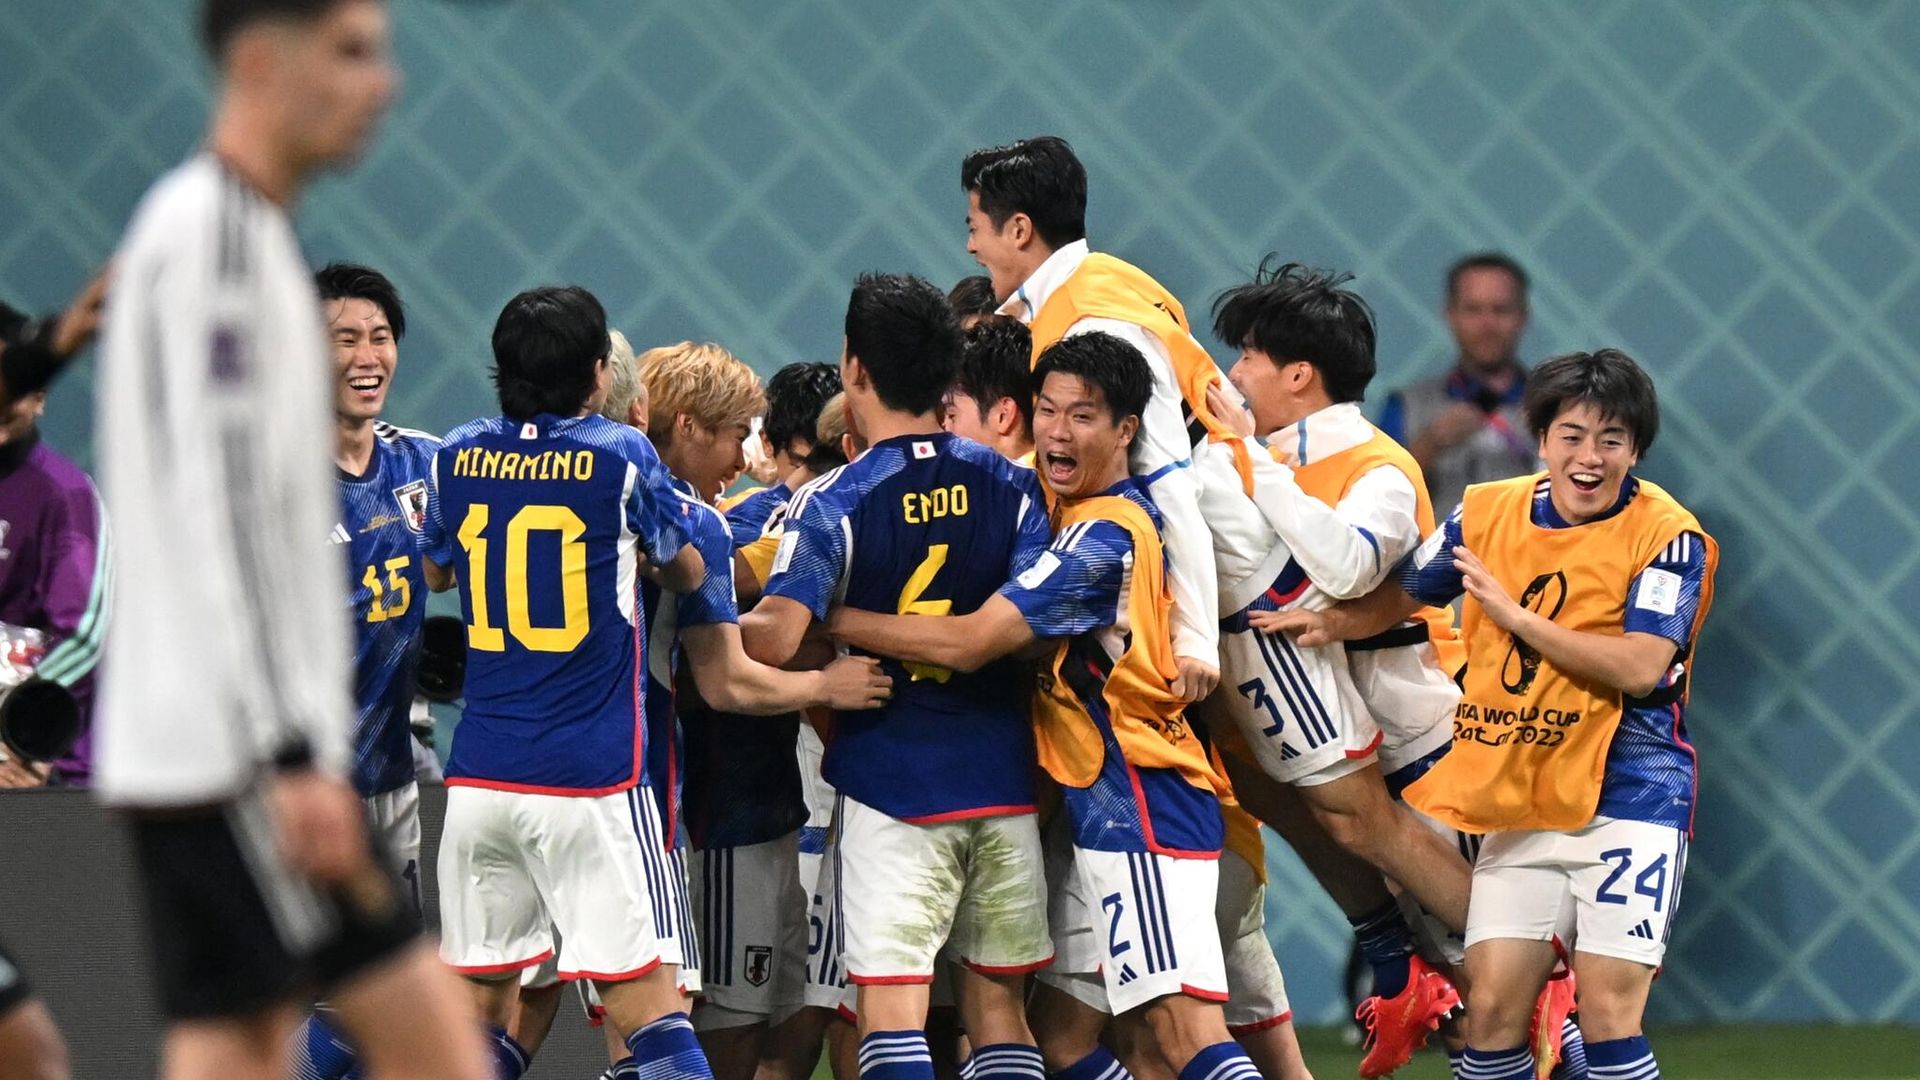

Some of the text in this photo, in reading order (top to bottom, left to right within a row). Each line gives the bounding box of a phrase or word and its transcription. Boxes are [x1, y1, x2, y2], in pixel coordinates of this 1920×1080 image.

[454, 447, 594, 481] MINAMINO
[902, 484, 969, 524] ENDO
[362, 556, 411, 623] 15
[456, 503, 591, 653] 10
[1237, 677, 1284, 738] 3
[1455, 703, 1581, 727] IFA WOLD CUP
[1513, 725, 1565, 747] 2022
[1595, 847, 1668, 913] 24
[1102, 891, 1131, 959] 2
